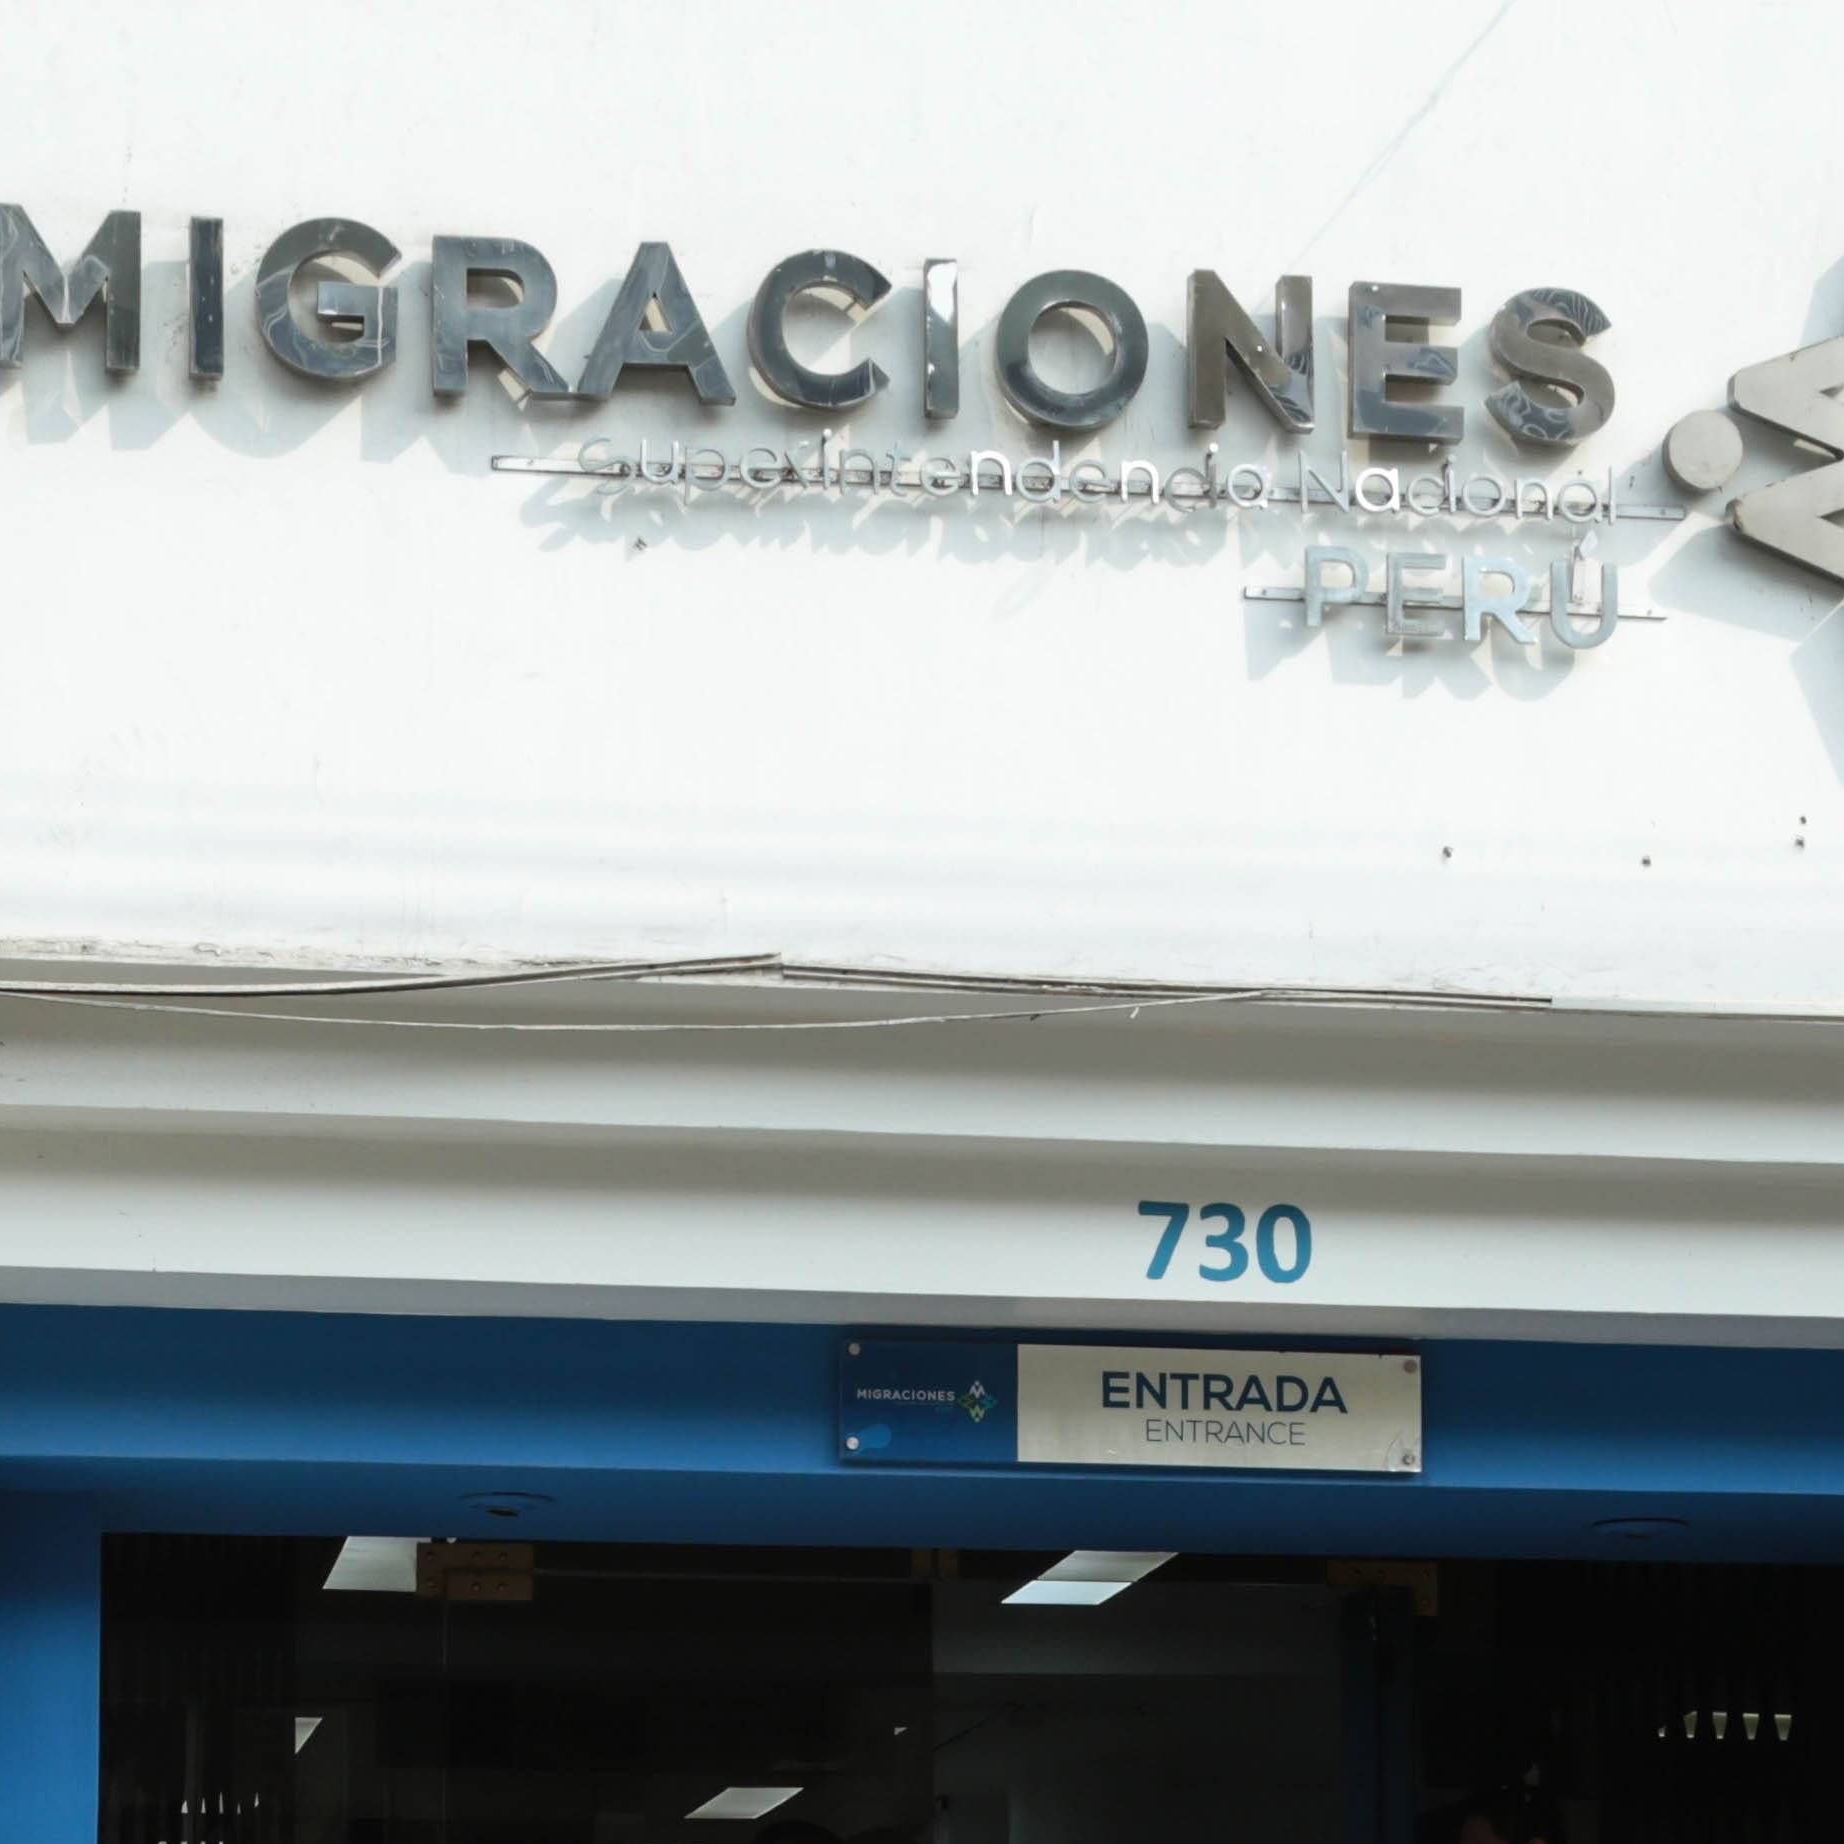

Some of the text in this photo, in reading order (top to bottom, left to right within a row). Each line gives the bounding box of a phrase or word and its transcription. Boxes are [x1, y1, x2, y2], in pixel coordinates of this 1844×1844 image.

[1299, 450, 1619, 525] Nacional
[1303, 530, 1619, 650] PERÚ
[1137, 1200, 1312, 1285] 730
[856, 1388, 956, 1401] MIGRACIONES
[1102, 1371, 1348, 1414] ENTRADA
[1146, 1418, 1306, 1446] ENTRANCE
